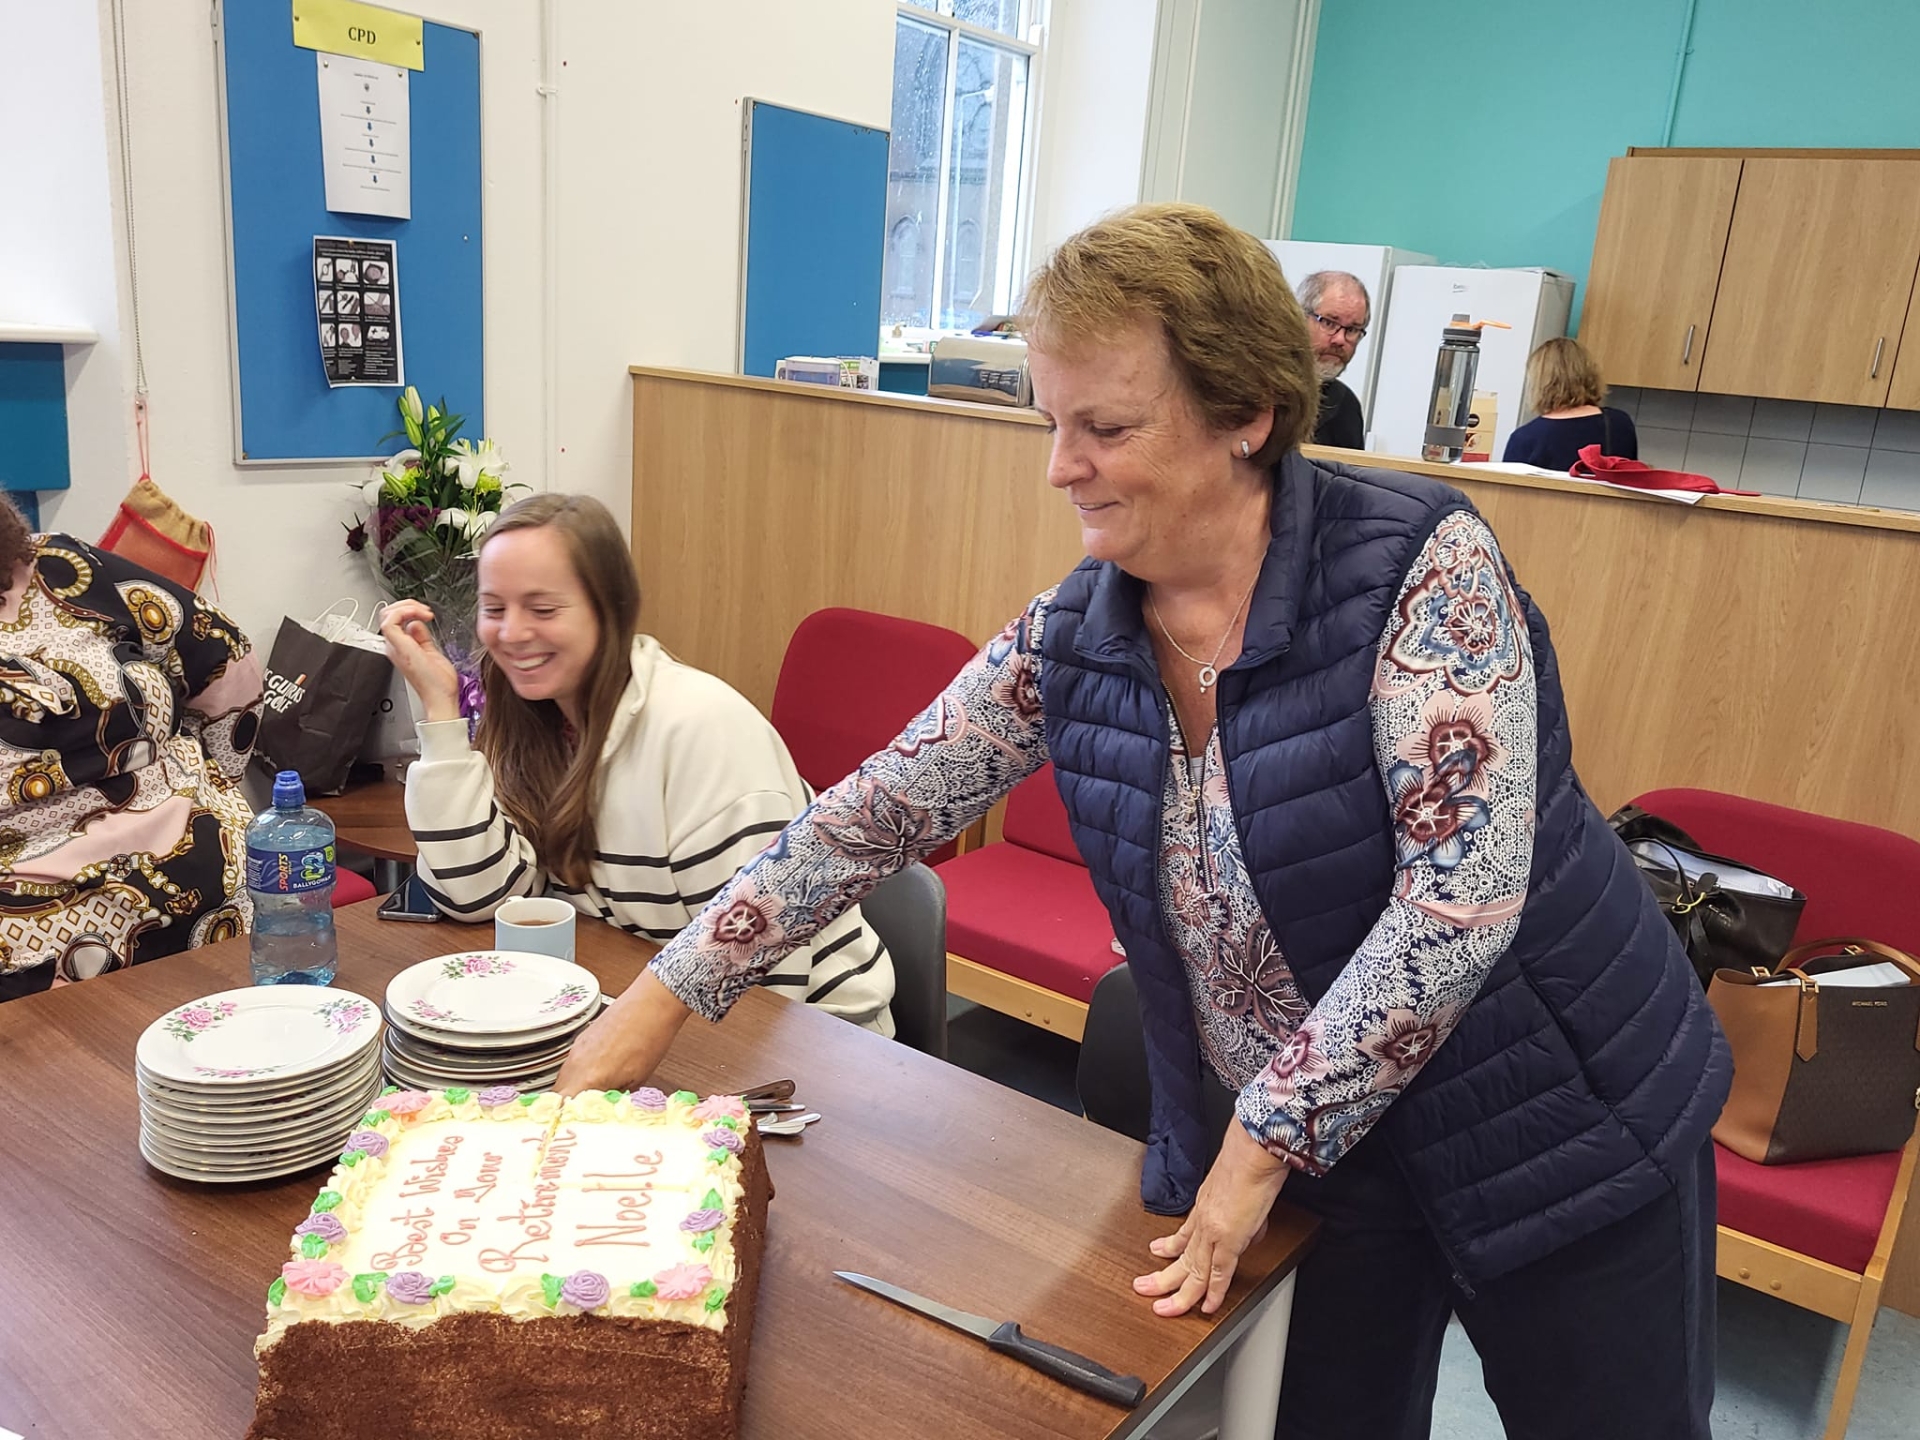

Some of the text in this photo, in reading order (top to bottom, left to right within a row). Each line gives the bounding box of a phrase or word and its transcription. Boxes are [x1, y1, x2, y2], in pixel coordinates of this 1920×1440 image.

[348, 26, 376, 45] CPD
[263, 690, 293, 714] GOLF
[278, 853, 289, 892] SPORTS
[370, 1135, 464, 1271] Best Wishes
[453, 1152, 503, 1203] Your
[478, 1129, 578, 1272] Retirement
[574, 1150, 663, 1247] Noelle
